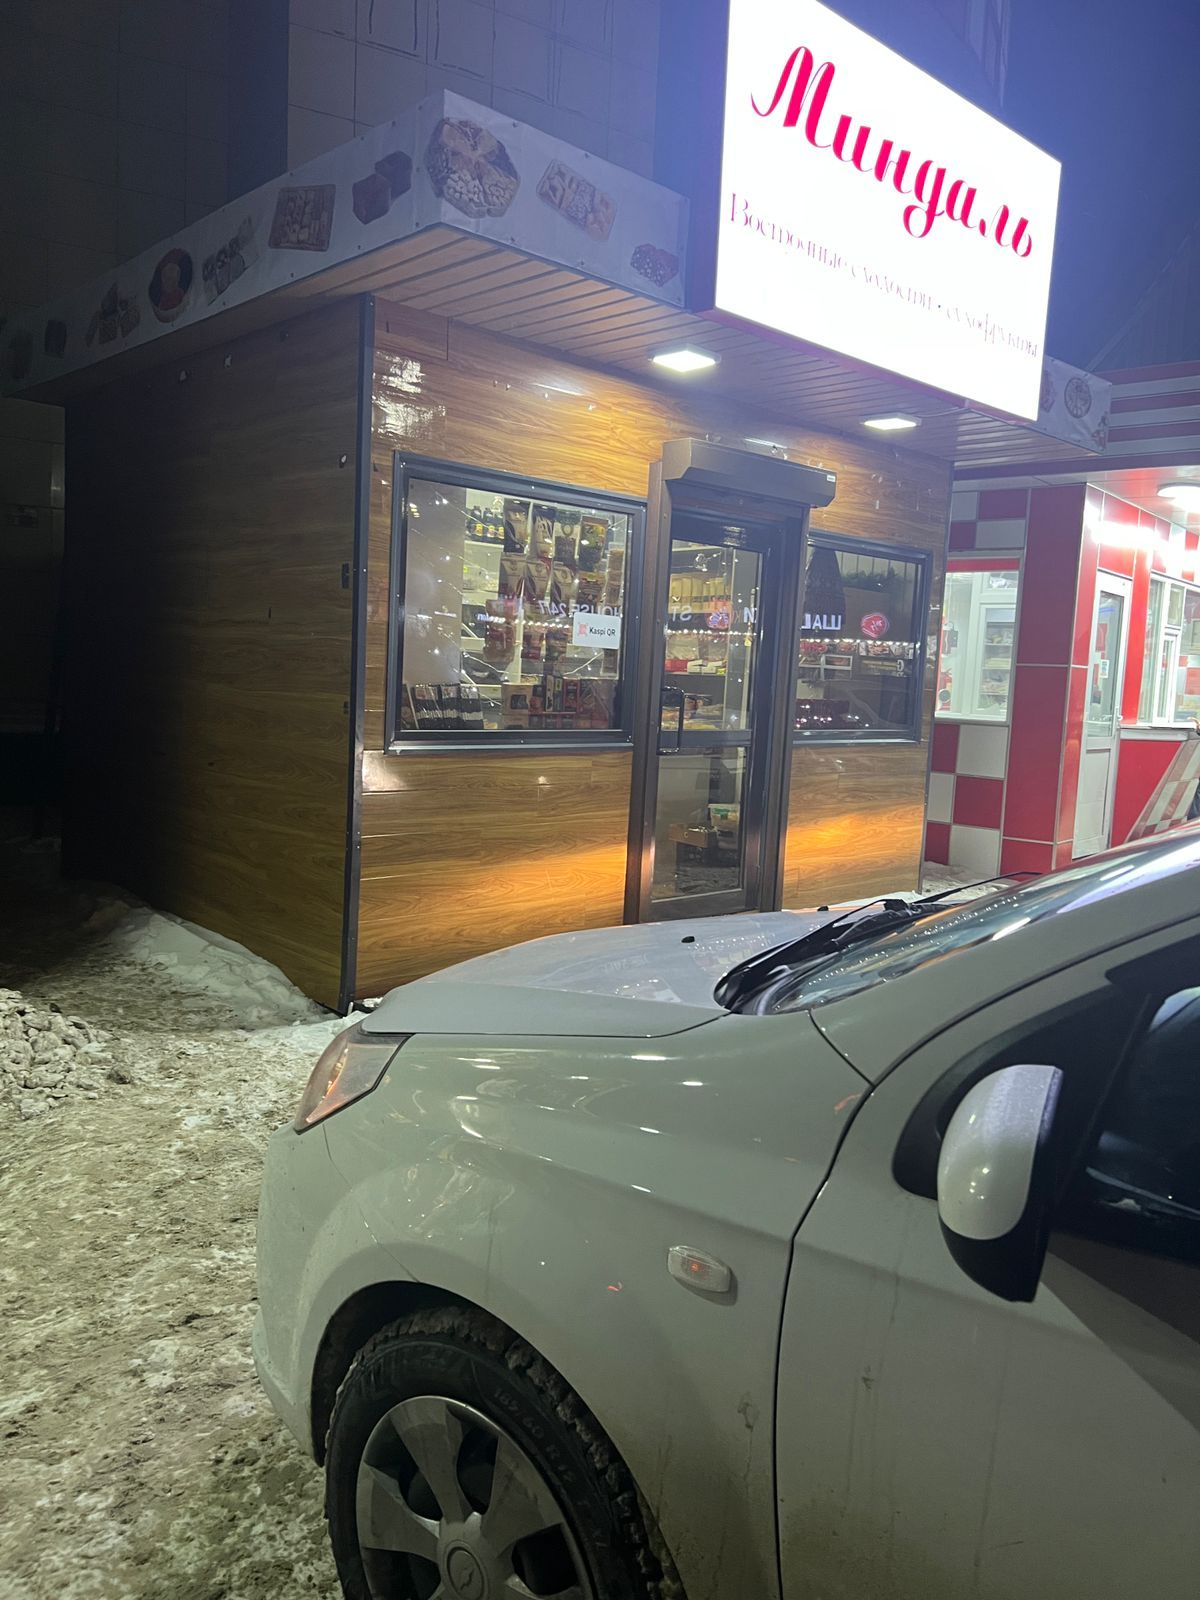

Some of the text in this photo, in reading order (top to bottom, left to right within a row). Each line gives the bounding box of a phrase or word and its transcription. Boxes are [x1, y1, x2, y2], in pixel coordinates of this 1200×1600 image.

[750, 45, 1033, 258] Миндаль
[589, 626, 616, 637] Kaspi QR
